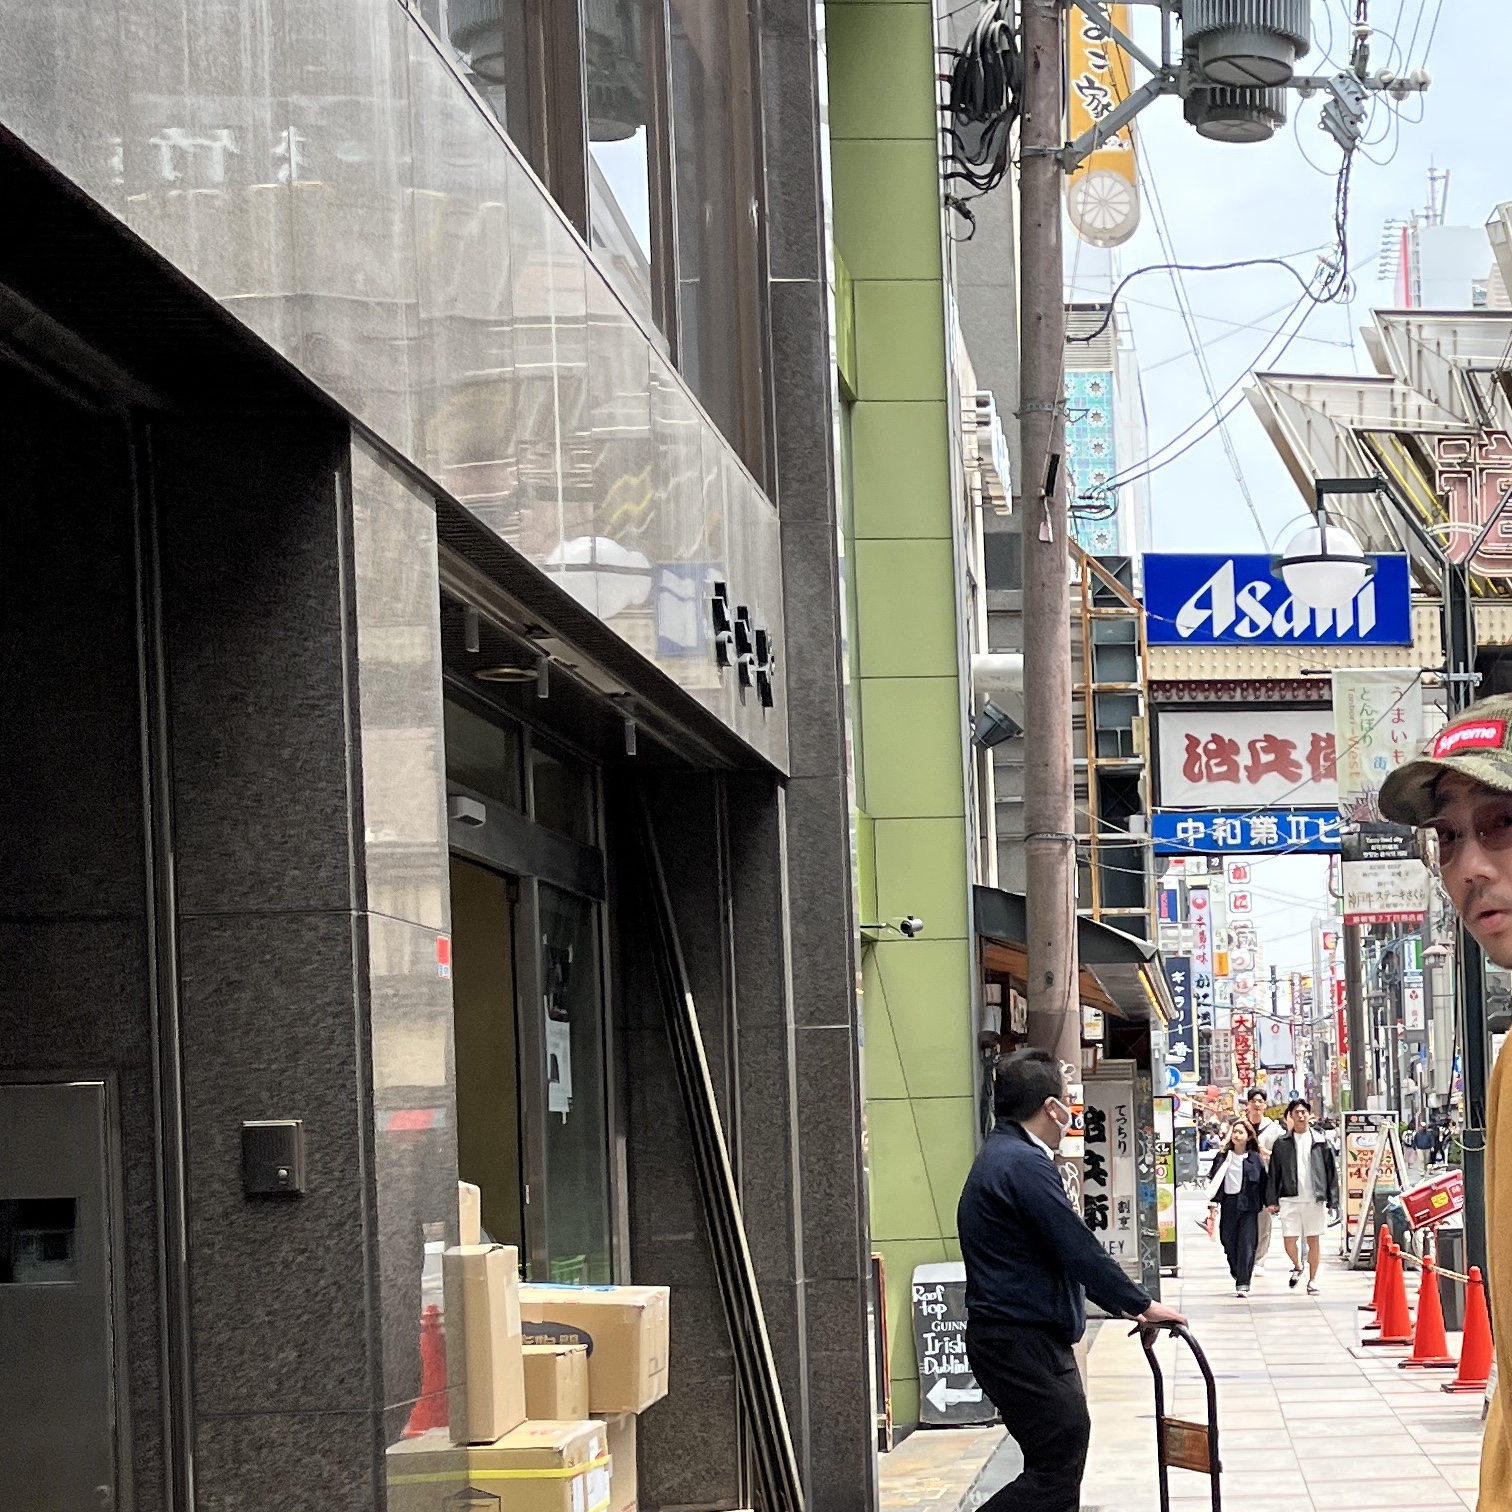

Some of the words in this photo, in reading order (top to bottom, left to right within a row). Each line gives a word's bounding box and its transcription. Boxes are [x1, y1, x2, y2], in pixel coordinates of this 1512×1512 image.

[1437, 727, 1497, 754] Supreme
[911, 1284, 946, 1303] Roof
[918, 1300, 948, 1321] top
[922, 1332, 967, 1356] Irish
